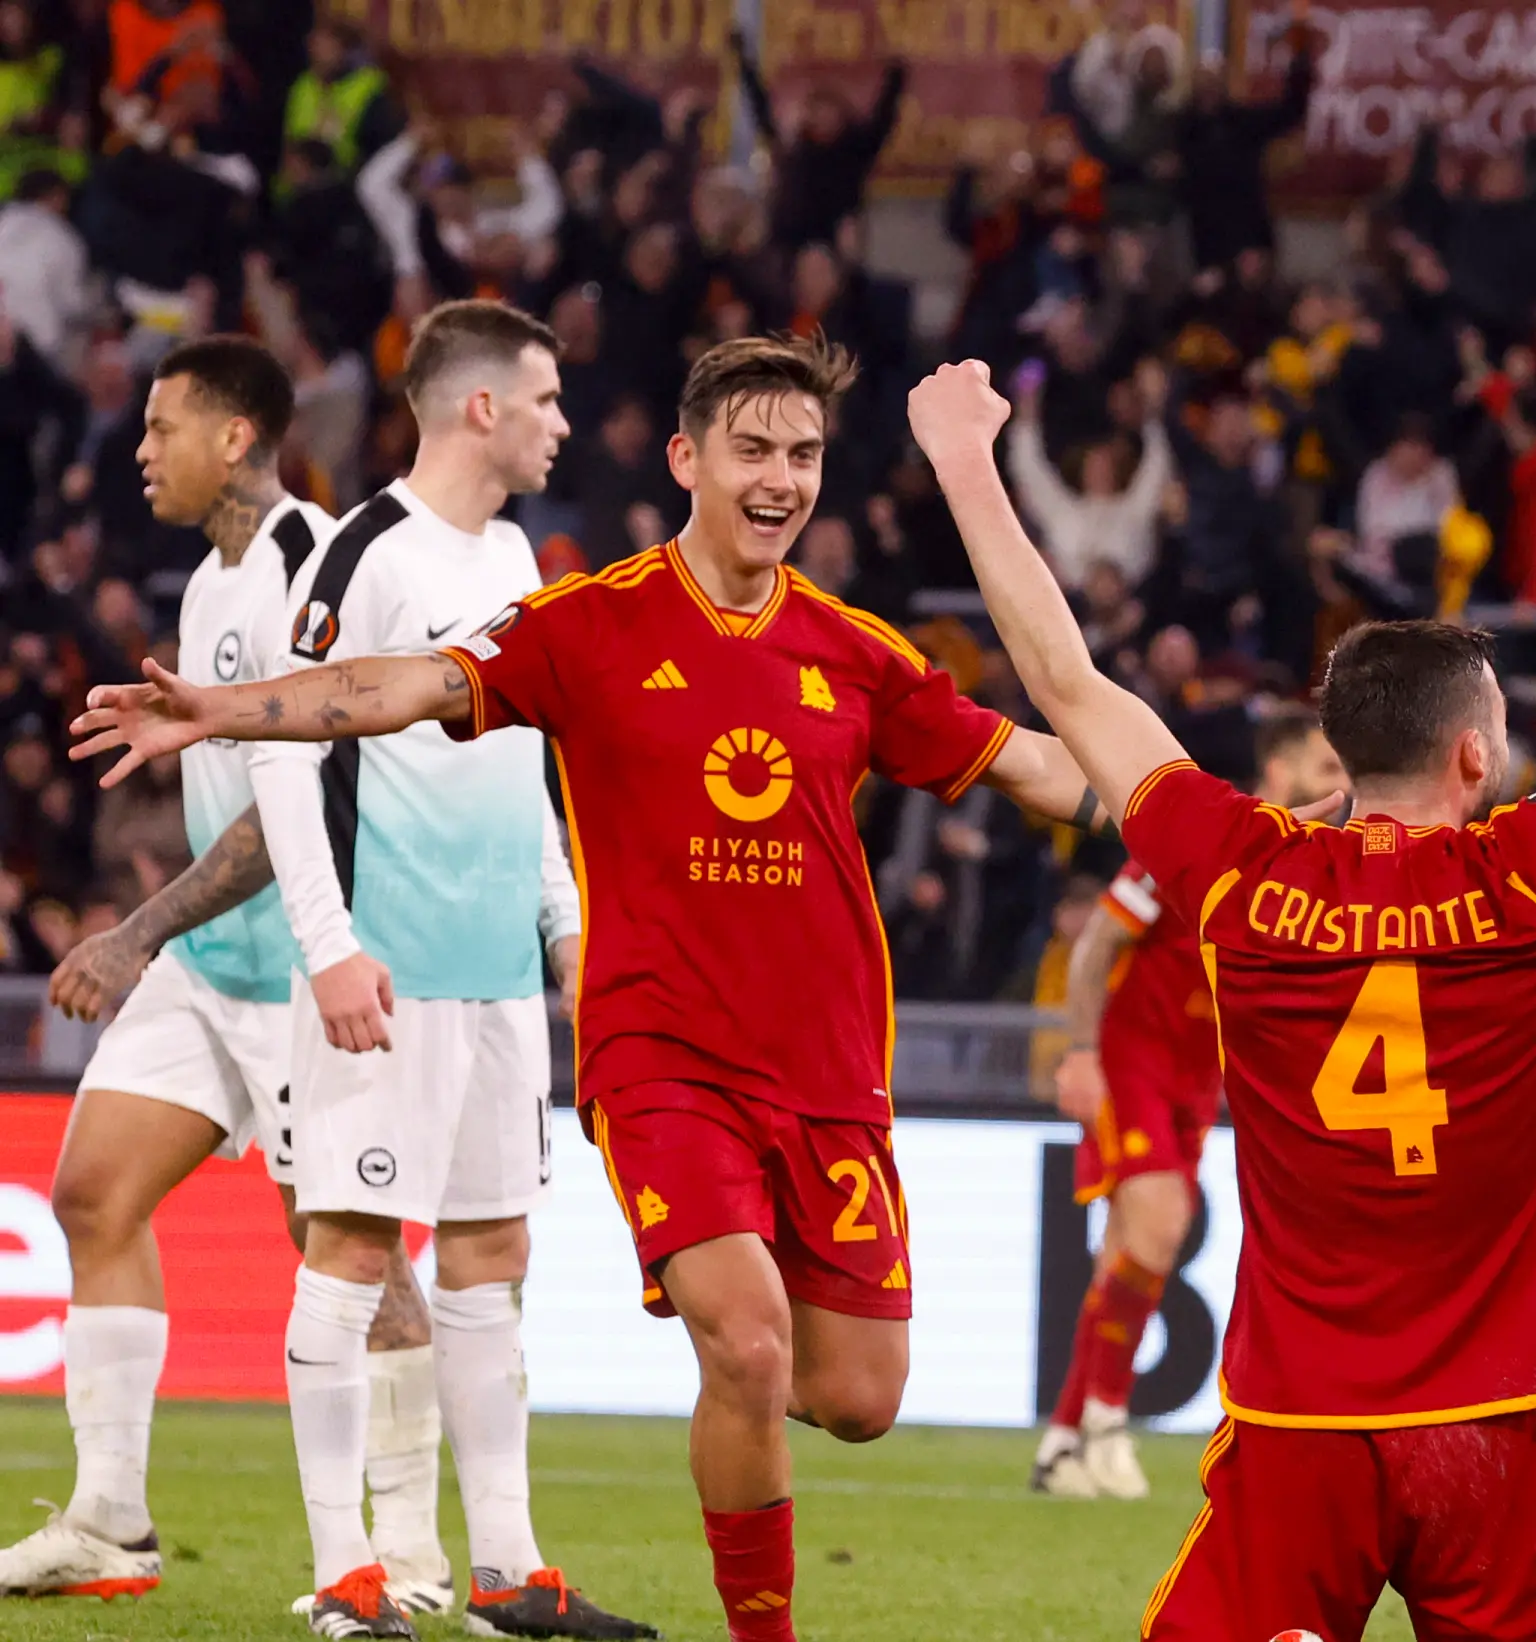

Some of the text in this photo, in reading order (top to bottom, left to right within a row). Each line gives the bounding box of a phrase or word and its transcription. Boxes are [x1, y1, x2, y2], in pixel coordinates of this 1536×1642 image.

[688, 861, 803, 886] SEASON
[689, 836, 803, 861] RIYADH
[1248, 880, 1498, 952] CRISTANTE
[1311, 956, 1449, 1176] 4
[827, 1154, 899, 1243] 21
